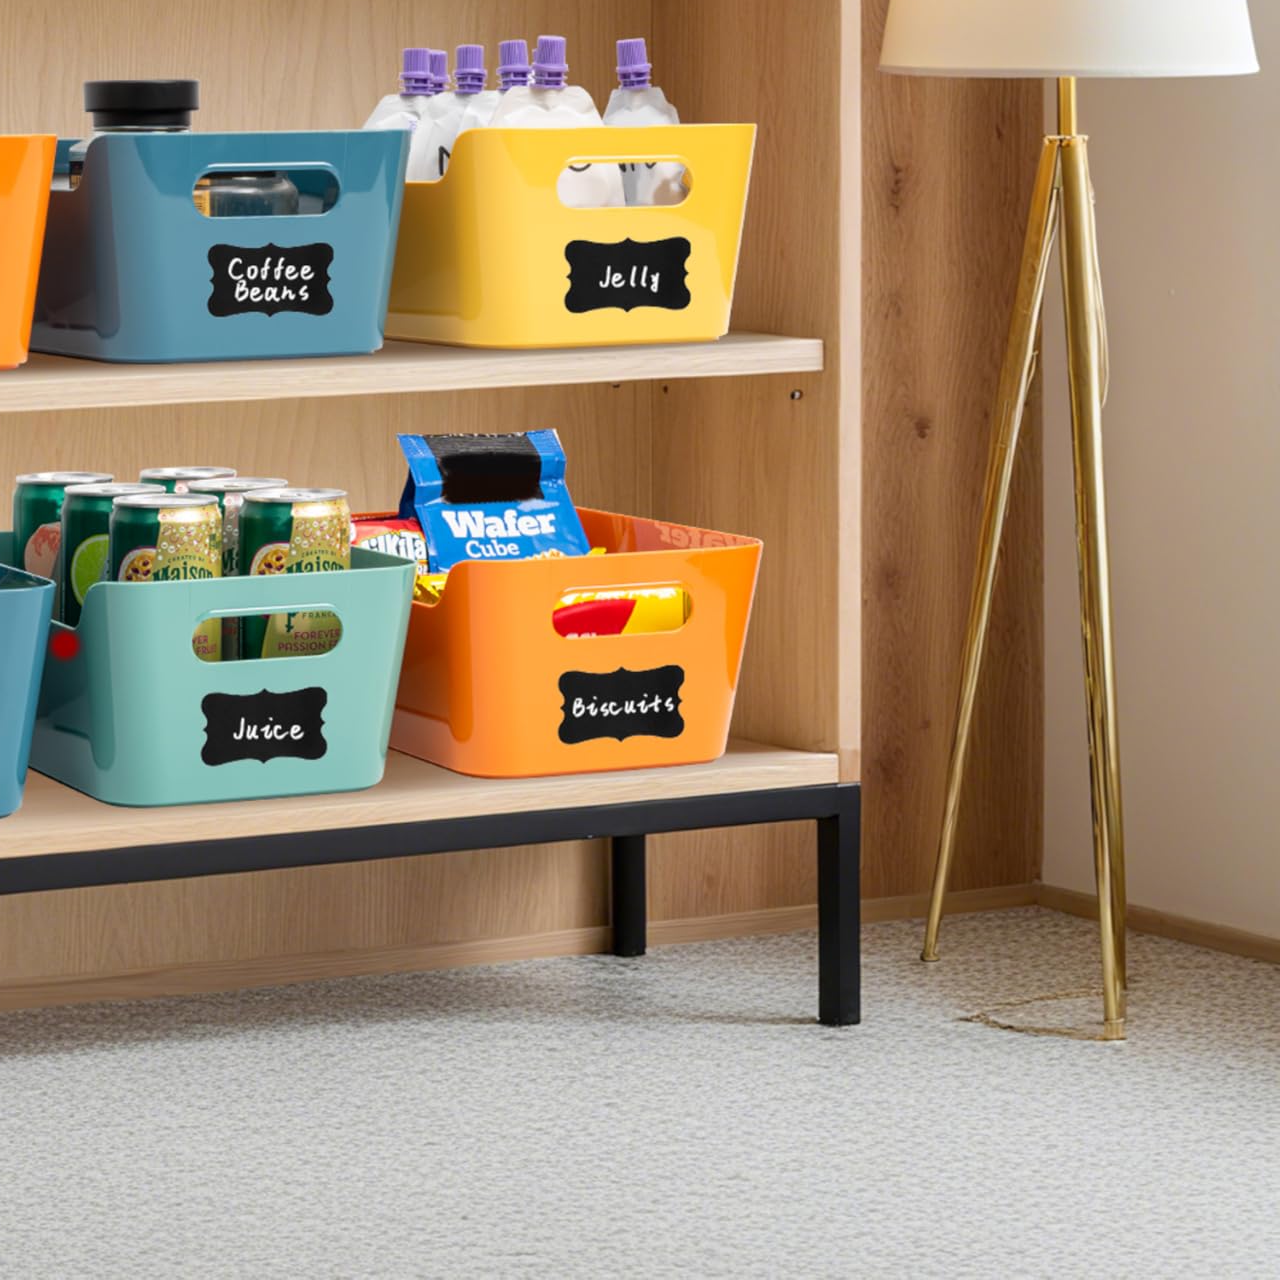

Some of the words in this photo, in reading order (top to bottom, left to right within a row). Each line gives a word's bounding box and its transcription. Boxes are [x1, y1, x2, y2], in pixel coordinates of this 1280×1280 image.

[227, 256, 315, 280] Coffee
[598, 265, 660, 293] Jelly
[233, 279, 310, 303] Beans
[441, 508, 557, 539] Wafer
[465, 539, 521, 559] Cube
[572, 692, 675, 718] Biscuits
[232, 716, 305, 740] Juice
